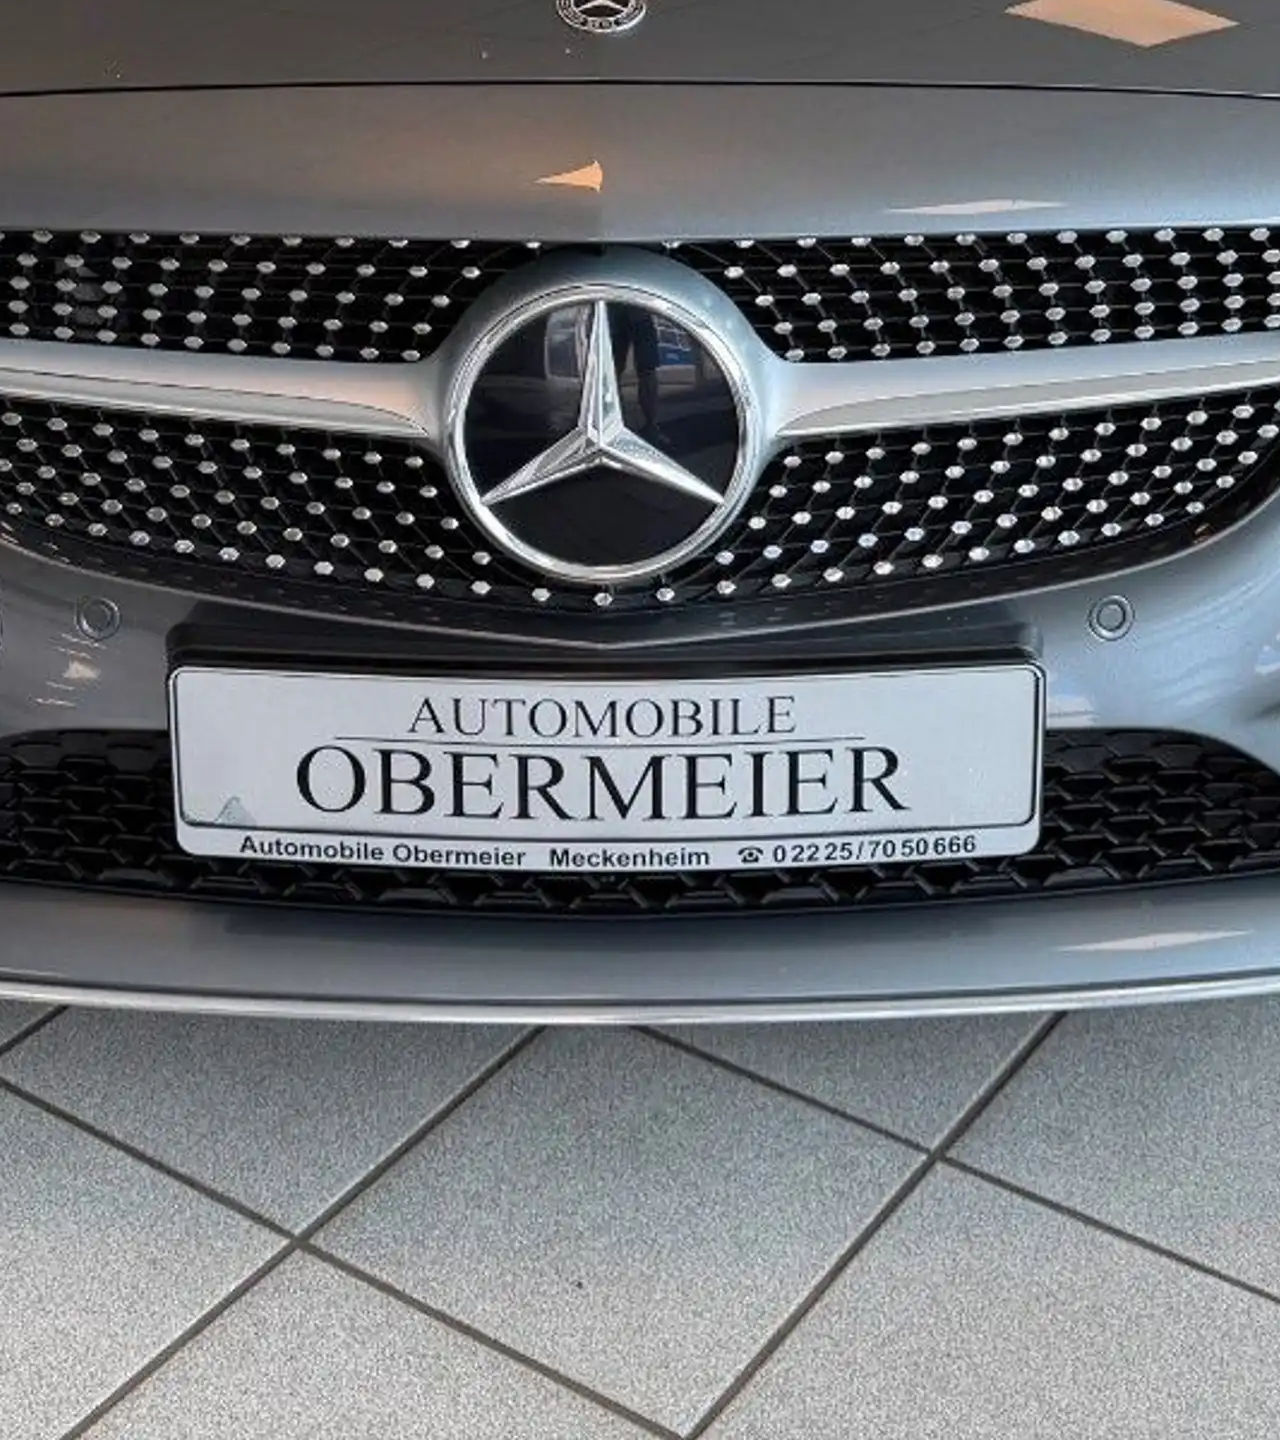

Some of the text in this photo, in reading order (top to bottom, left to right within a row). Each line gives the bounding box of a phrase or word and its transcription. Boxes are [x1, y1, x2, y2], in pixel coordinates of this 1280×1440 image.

[406, 695, 796, 737] AUTOMOBILE
[296, 745, 910, 822] OBERMEIER
[239, 835, 385, 861] Automobile
[392, 842, 526, 866] Obermeier
[549, 847, 711, 868] Meckenheim
